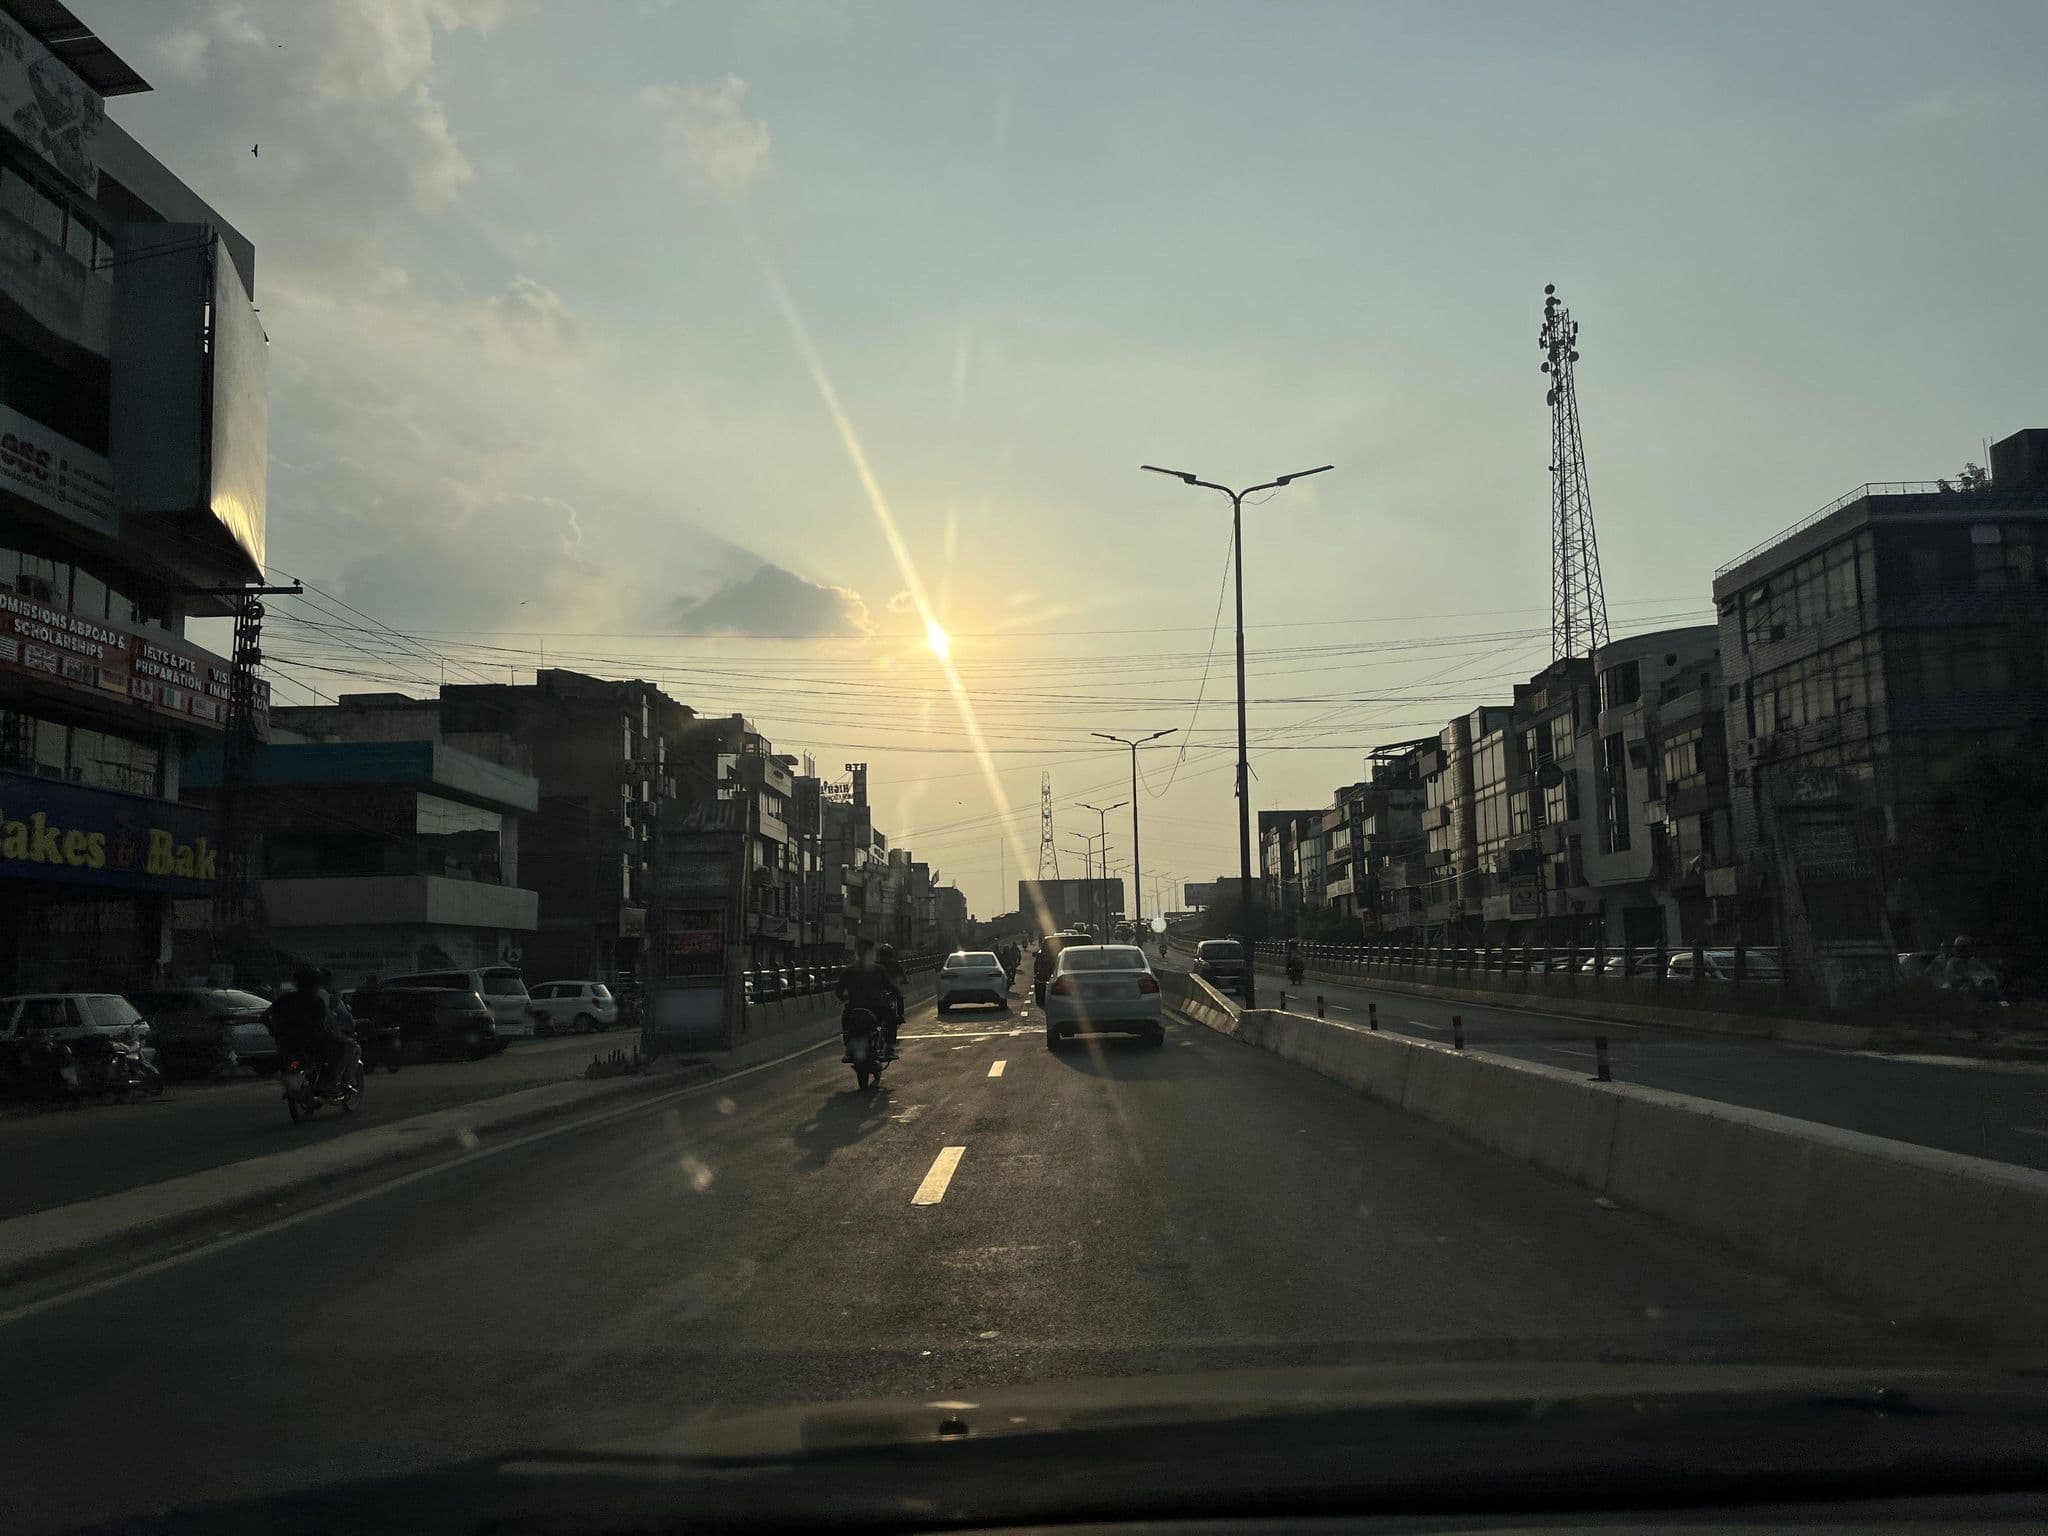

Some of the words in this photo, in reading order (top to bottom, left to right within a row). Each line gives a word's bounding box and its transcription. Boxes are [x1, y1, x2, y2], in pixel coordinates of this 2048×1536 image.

[14, 618, 104, 659] SCHOLARSHIPS
[69, 618, 116, 645] ABROAD
[118, 635, 126, 649] &
[135, 658, 203, 691] PREPARATION
[144, 644, 169, 664] IELTS
[169, 653, 178, 667] &
[179, 656, 196, 673] PTE
[0, 809, 106, 869] akes
